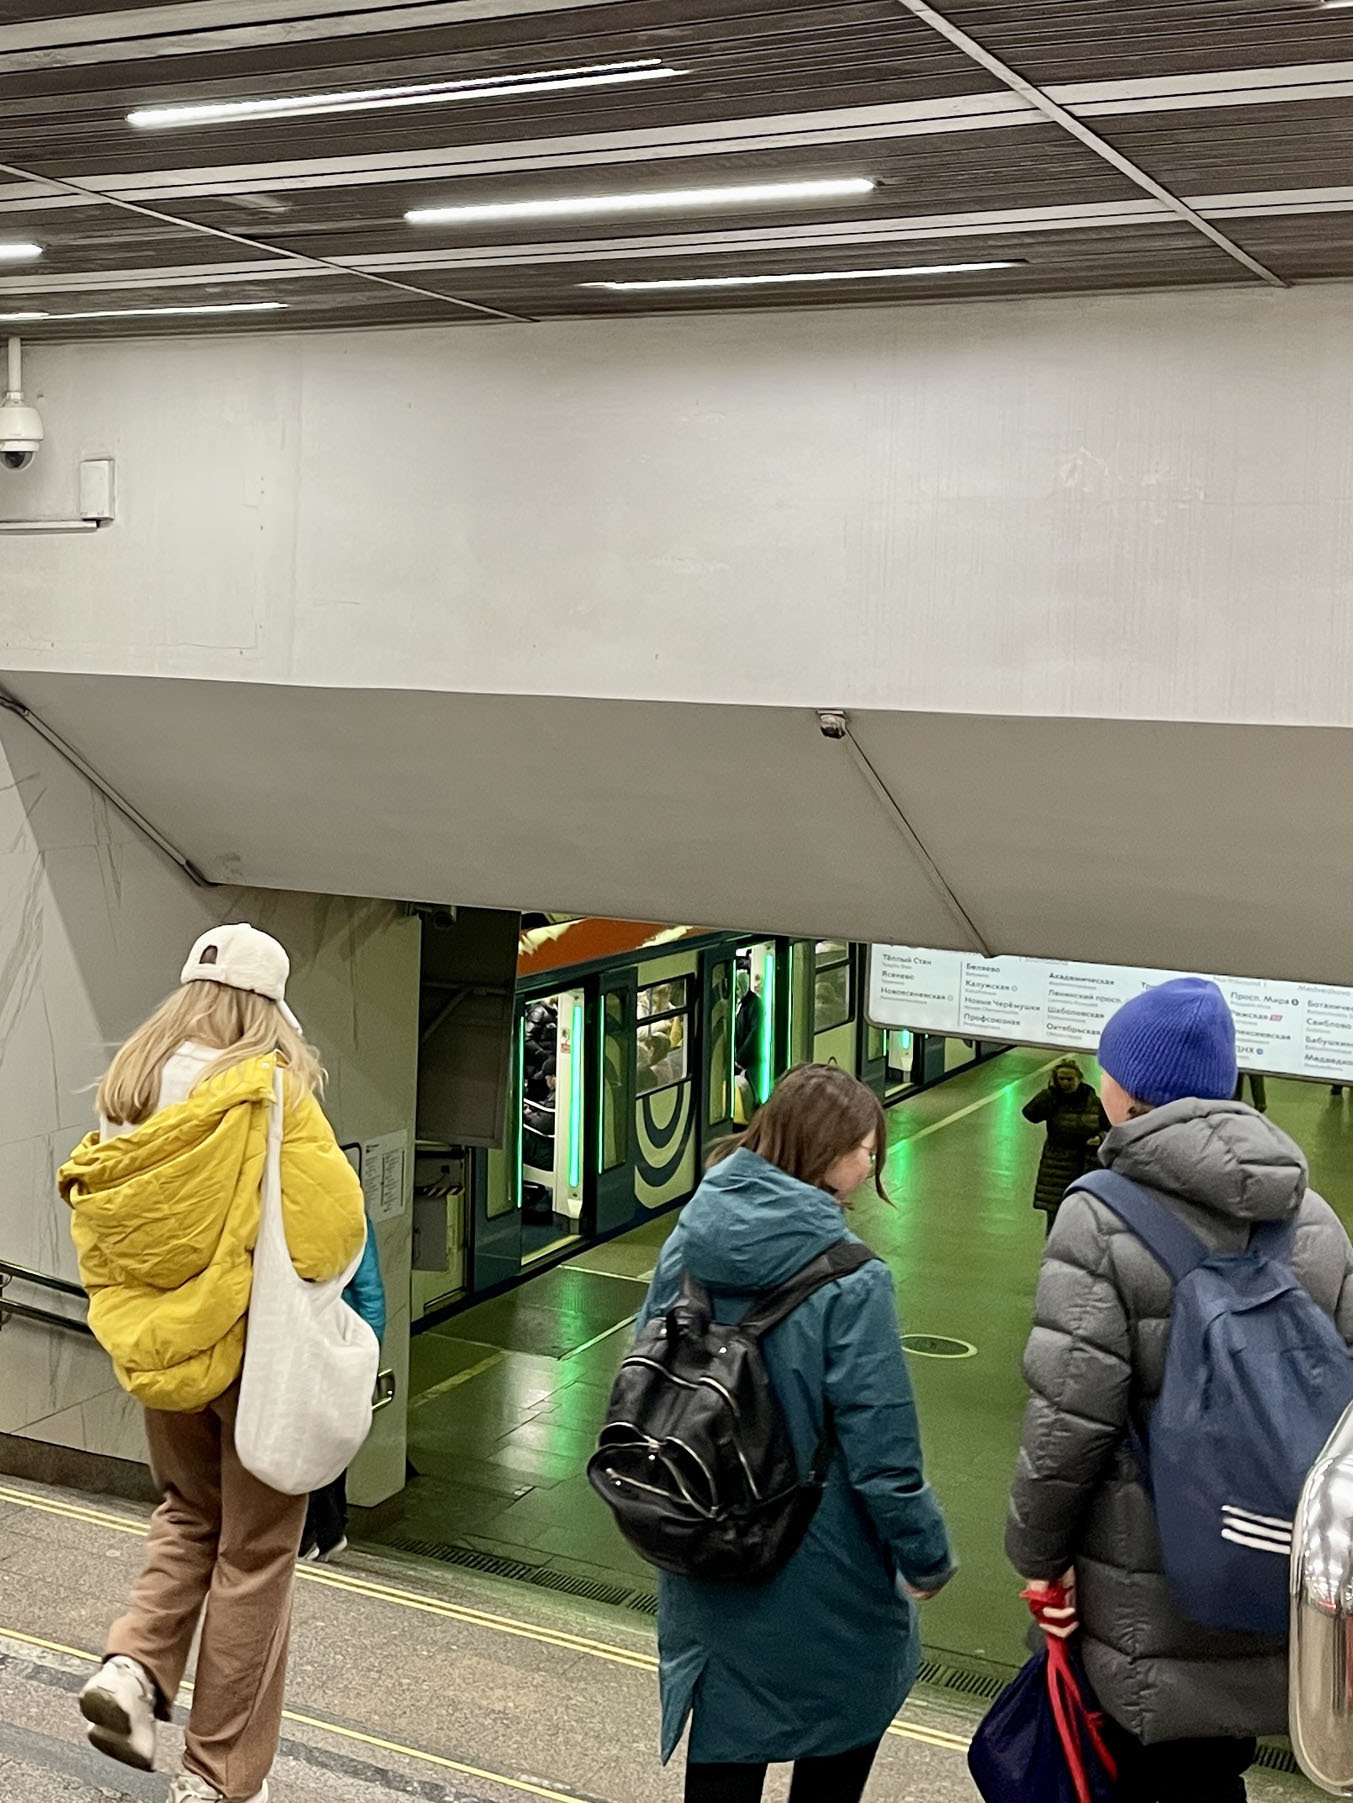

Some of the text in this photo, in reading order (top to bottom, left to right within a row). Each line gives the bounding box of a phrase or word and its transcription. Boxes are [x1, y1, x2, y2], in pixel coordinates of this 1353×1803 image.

[913, 957, 932, 965] Стан
[966, 963, 1001, 973] Беляево
[882, 970, 914, 980] Ясенево
[1049, 972, 1115, 986] Академическая
[965, 980, 1009, 991] Калужская
[880, 987, 946, 1000] Новоясеневская
[1048, 989, 1094, 1000] Ленинский
[965, 996, 992, 1006] Новые
[1264, 996, 1290, 1005] Мира
[1048, 1006, 1105, 1019] Шаболовская
[964, 1013, 1020, 1026] Профсоюзная
[1306, 1018, 1352, 1030] Свиблово
[1046, 1022, 1101, 1035] Октябрьская
